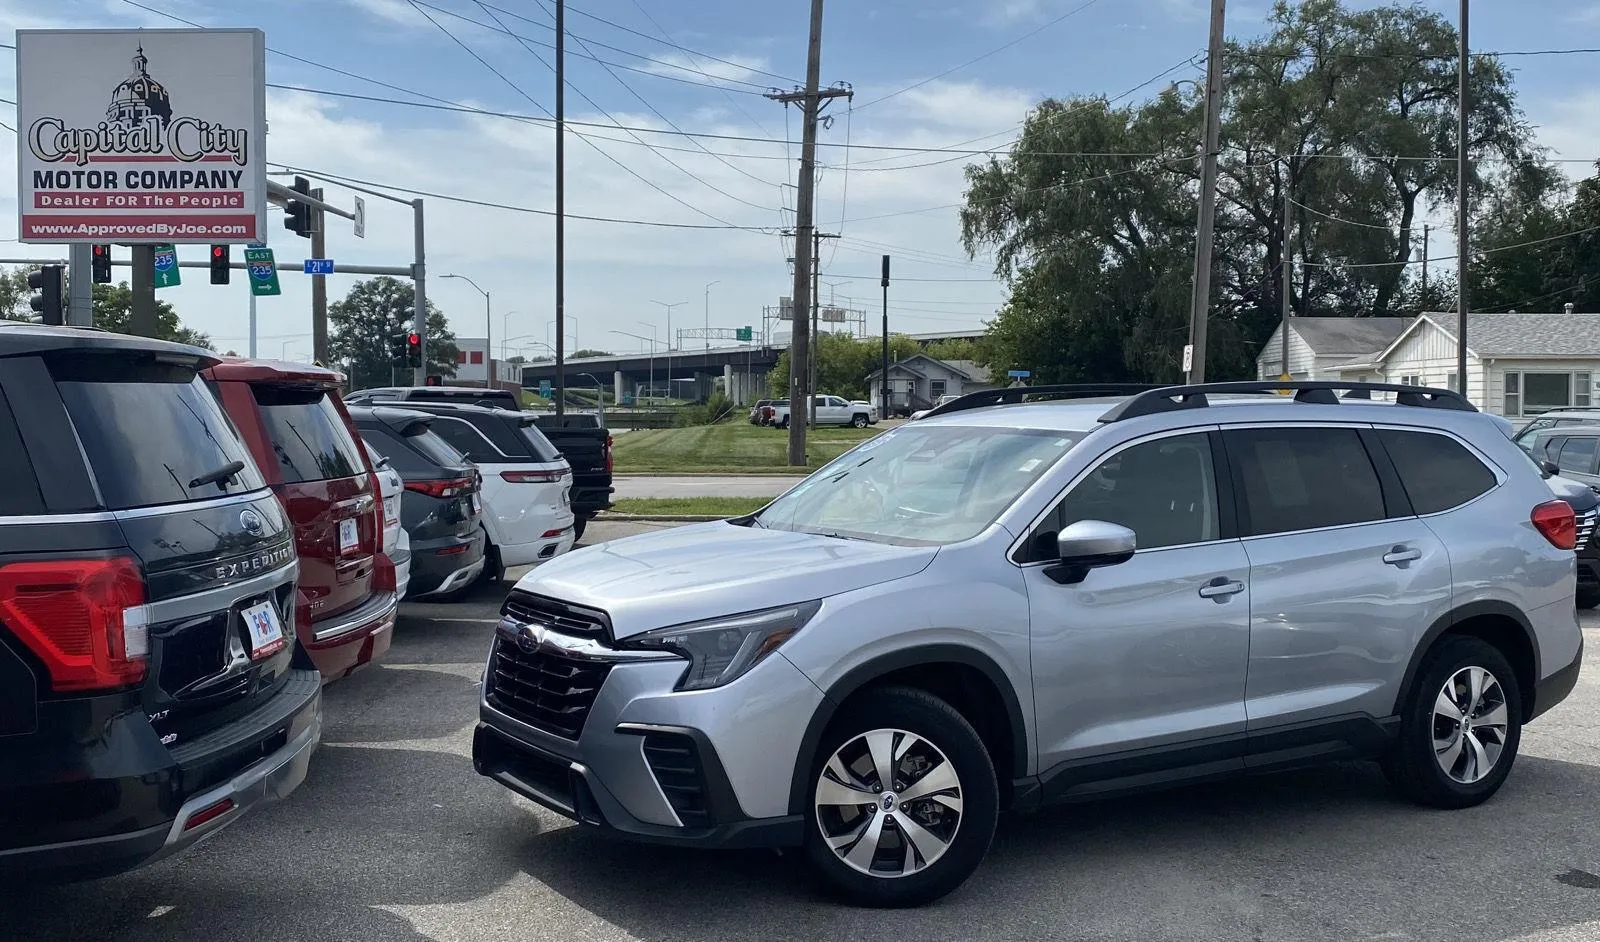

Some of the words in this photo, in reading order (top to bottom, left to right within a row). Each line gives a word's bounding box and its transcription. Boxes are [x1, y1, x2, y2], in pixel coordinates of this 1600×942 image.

[28, 116, 163, 166] Capital
[167, 116, 248, 166] City
[33, 170, 118, 189] MOTOR
[125, 170, 243, 189] COMPANY
[41, 195, 99, 206] Dealer
[106, 195, 138, 206] FOR
[143, 195, 174, 206] The
[179, 195, 238, 208] People
[31, 223, 247, 235] www.ApprovedByJoe.com
[155, 255, 173, 267] 235
[252, 265, 272, 276] 235
